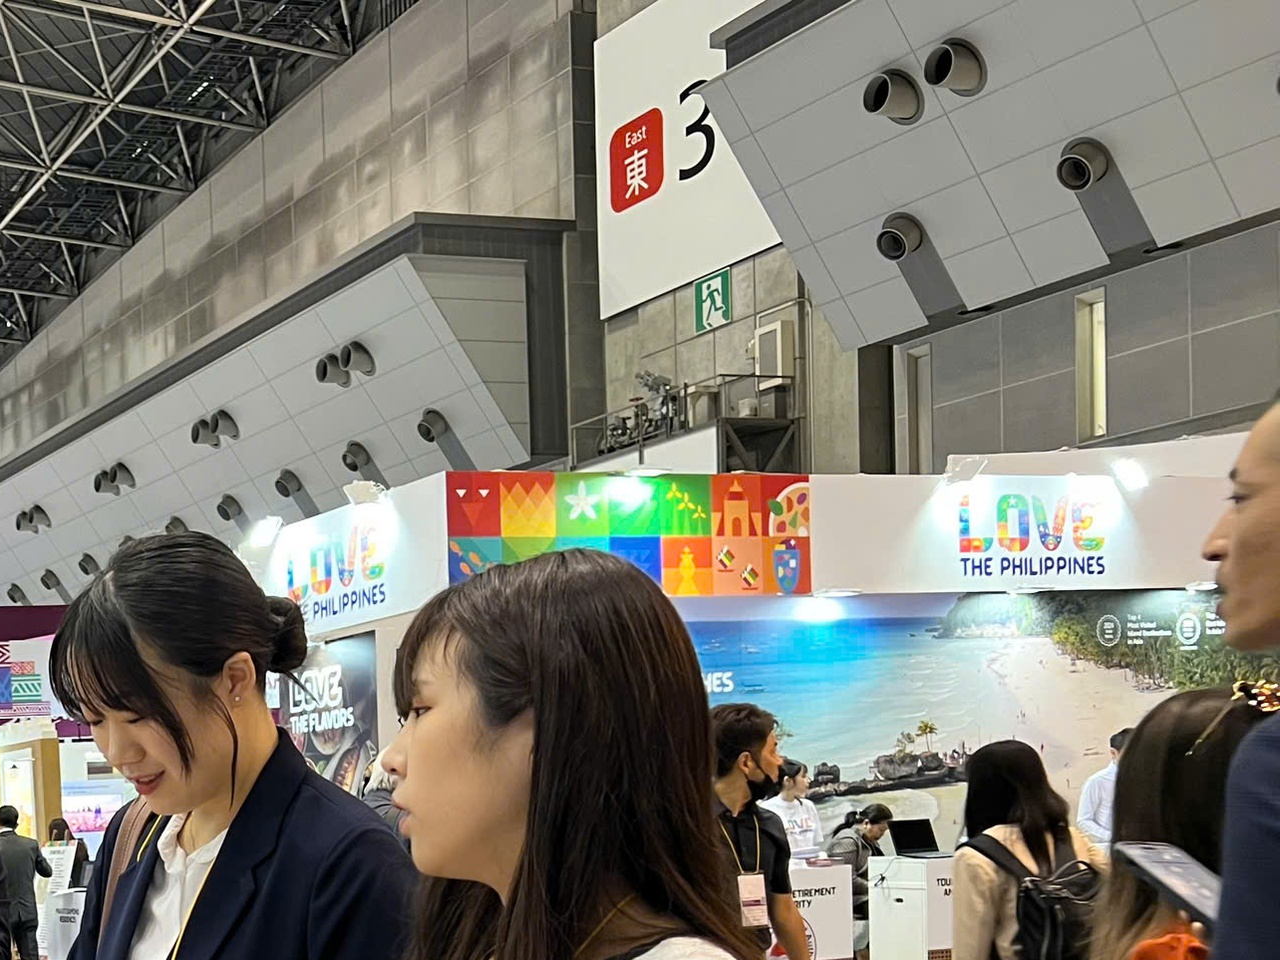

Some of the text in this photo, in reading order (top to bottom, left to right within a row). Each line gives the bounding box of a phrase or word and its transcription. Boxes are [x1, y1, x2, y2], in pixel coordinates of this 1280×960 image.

[624, 125, 648, 149] East
[678, 79, 716, 181] 3
[624, 148, 649, 199] 東
[959, 493, 1106, 553] LOVE
[287, 526, 386, 603] LOVE
[960, 555, 1106, 576] THE PHILIPPINES
[313, 582, 387, 620] PHILIPPINES
[288, 665, 343, 713] LOVE
[289, 706, 355, 733] THE FLAVORS
[792, 887, 837, 899] ETIREMENT
[794, 900, 812, 908] RITY
